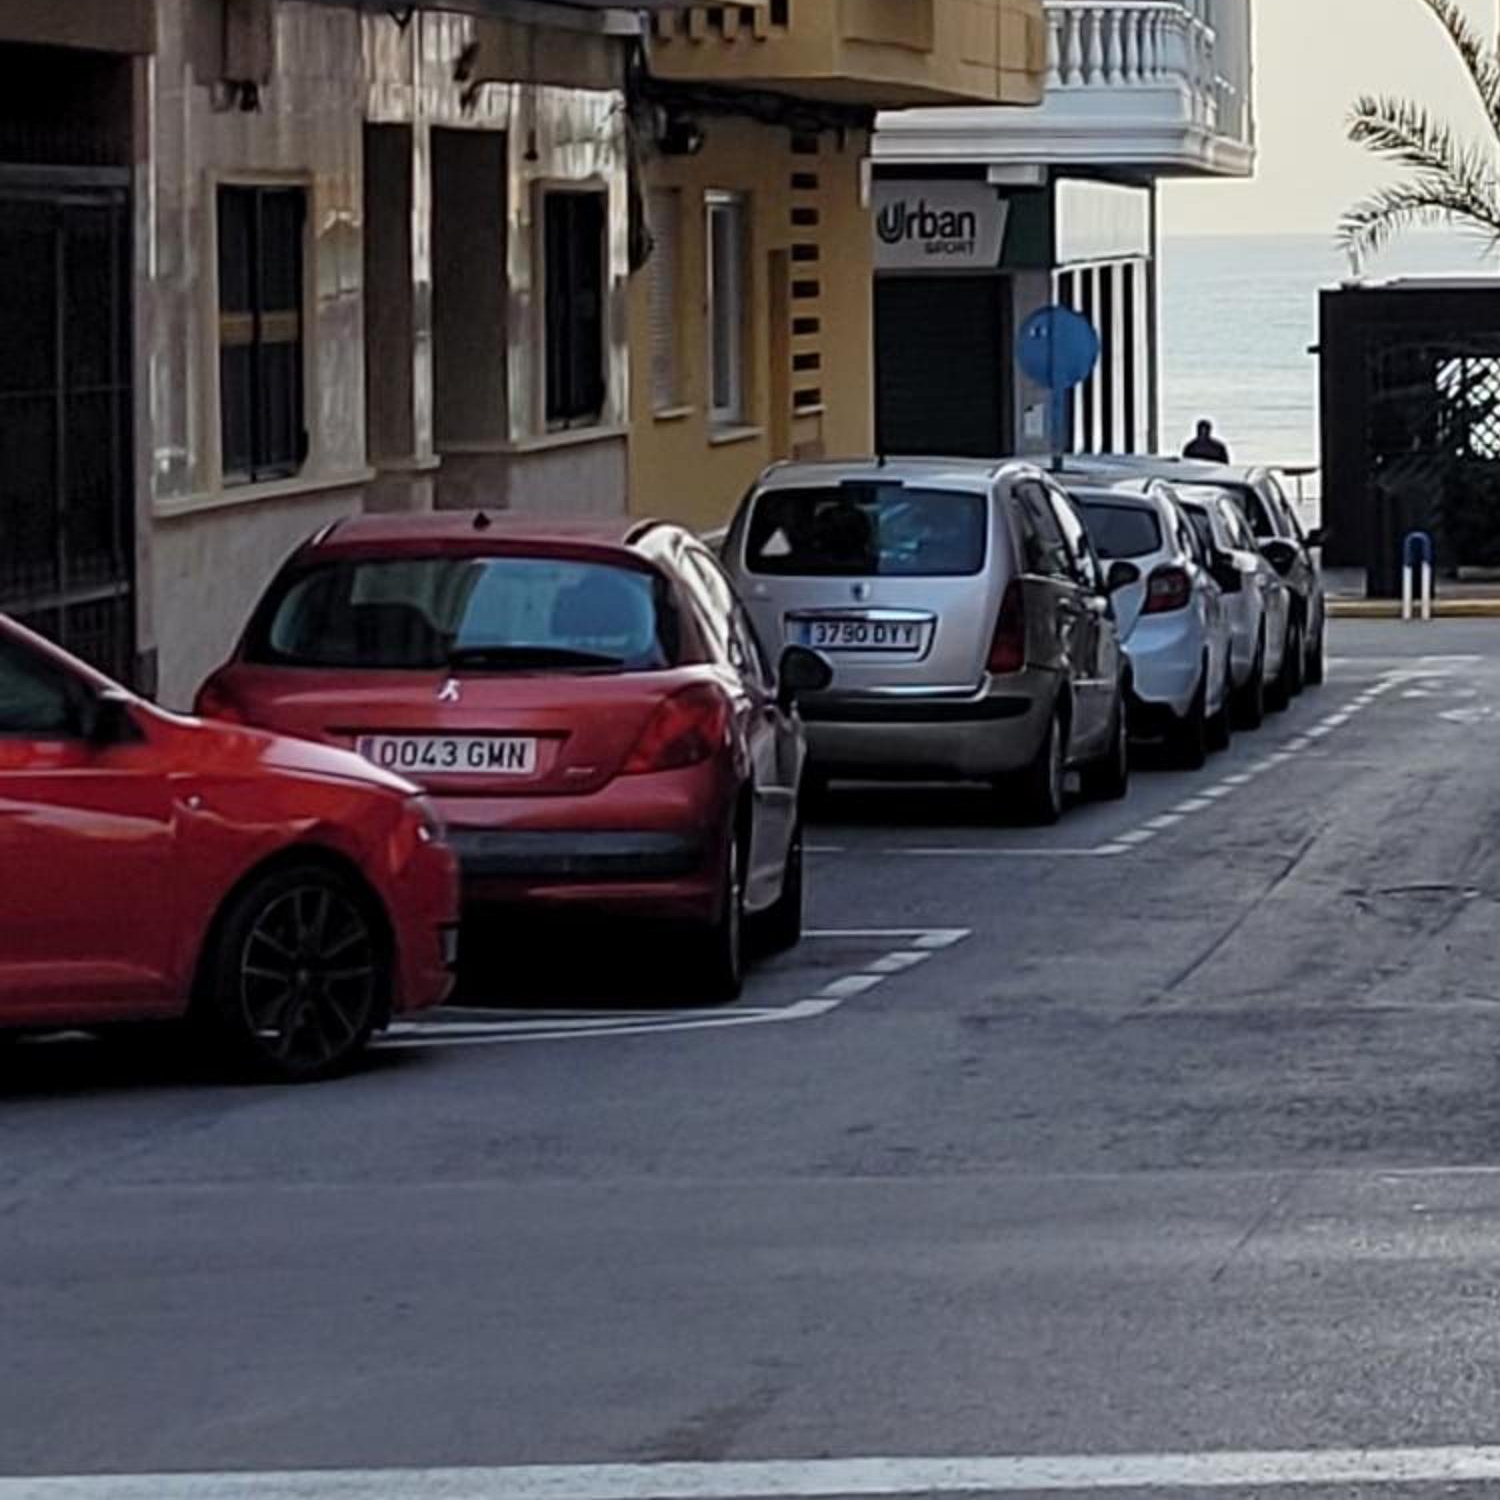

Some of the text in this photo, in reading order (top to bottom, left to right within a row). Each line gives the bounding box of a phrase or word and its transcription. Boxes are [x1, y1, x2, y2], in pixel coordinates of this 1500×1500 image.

[877, 198, 976, 244] Urban
[380, 740, 526, 769] 0043 GMN
